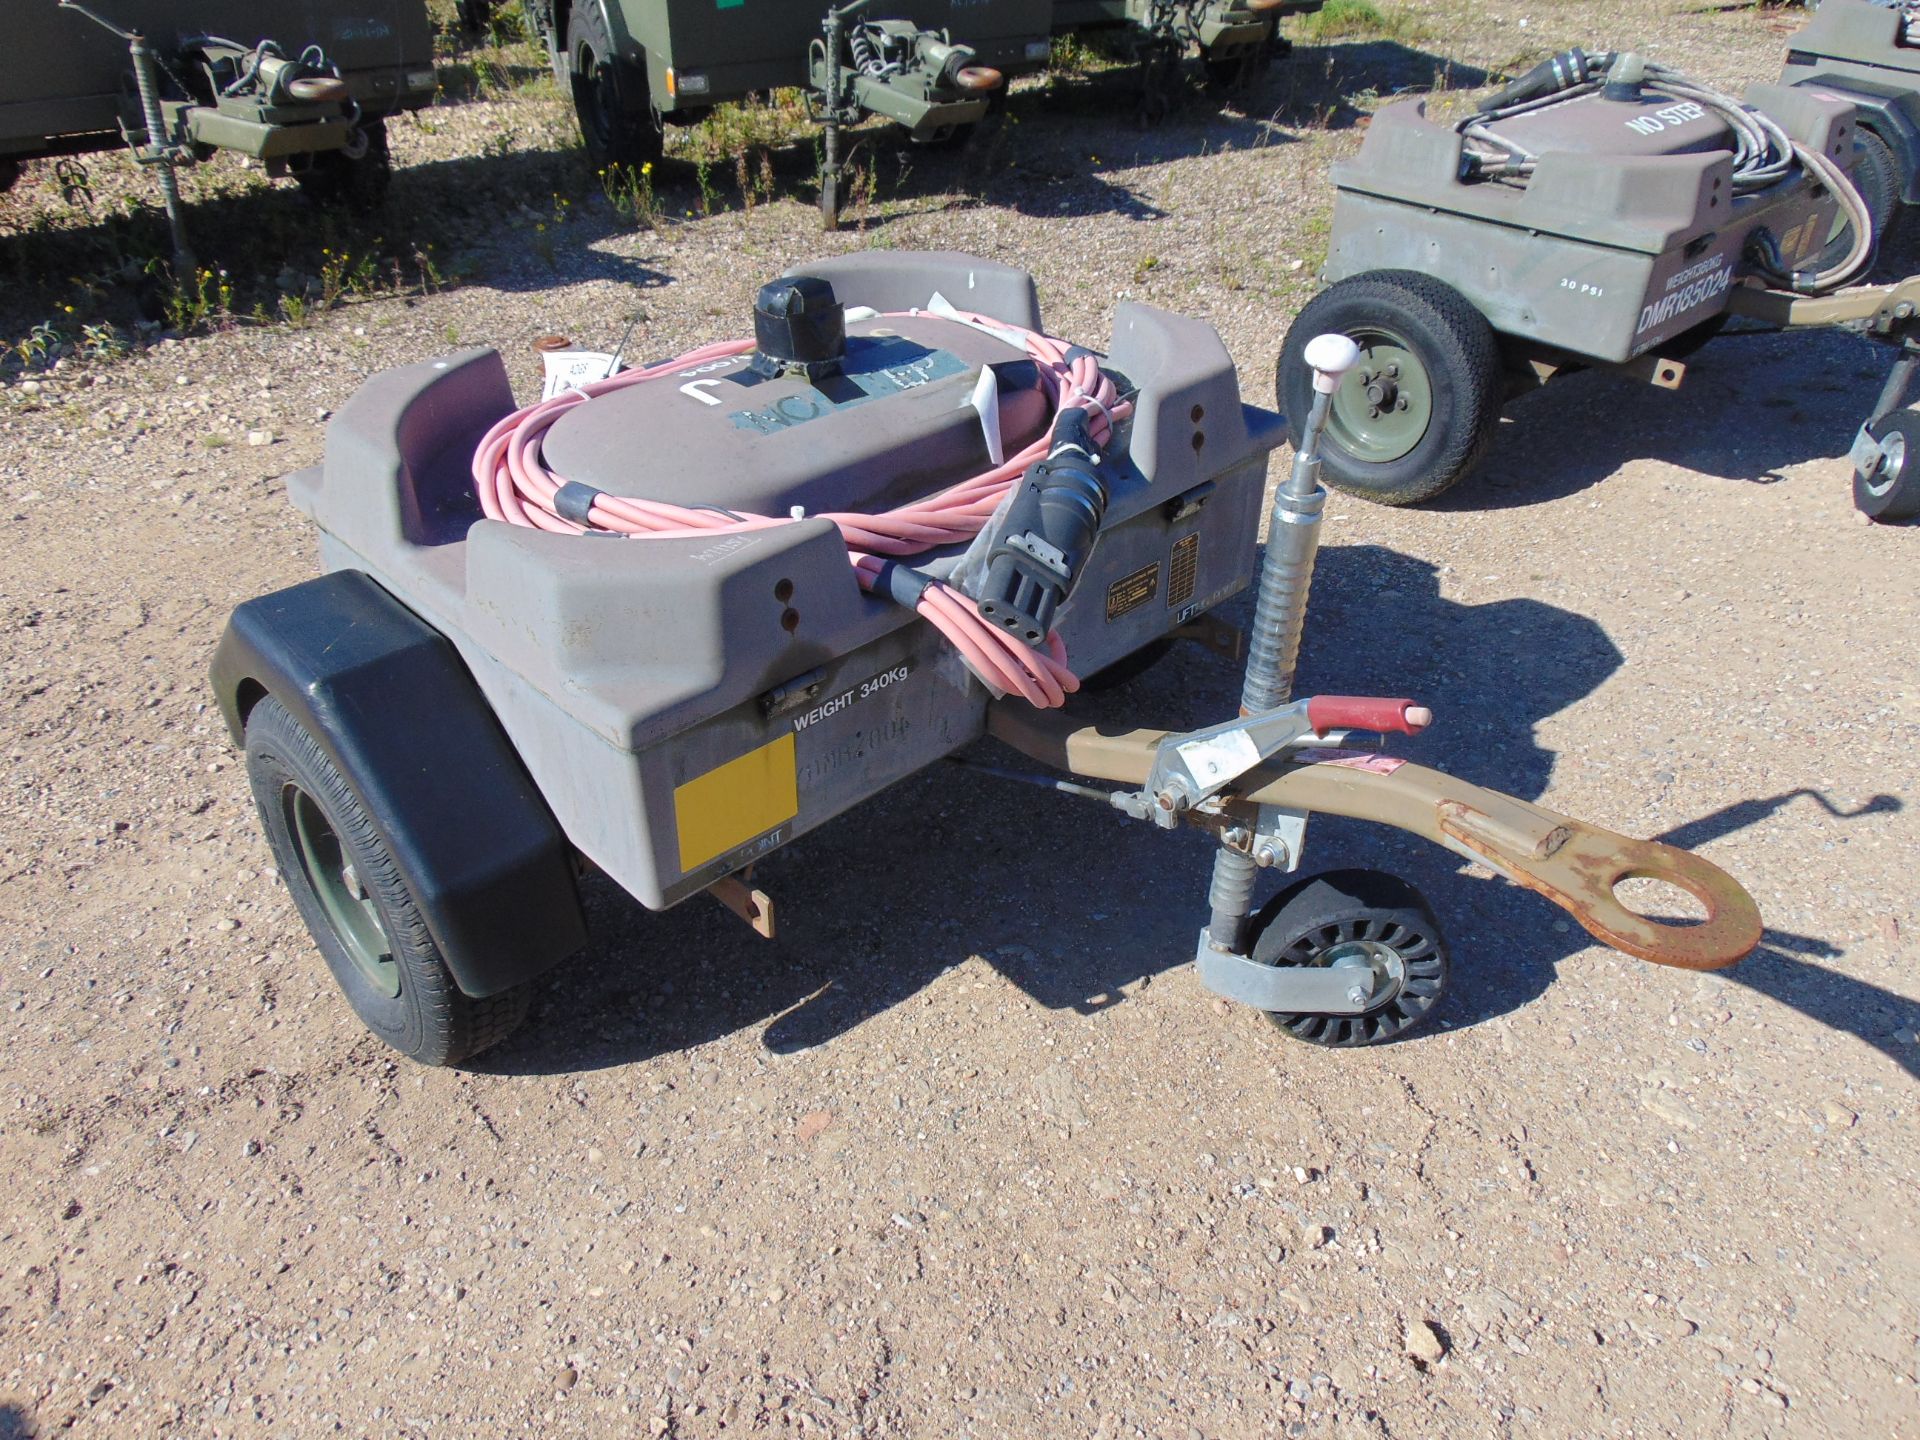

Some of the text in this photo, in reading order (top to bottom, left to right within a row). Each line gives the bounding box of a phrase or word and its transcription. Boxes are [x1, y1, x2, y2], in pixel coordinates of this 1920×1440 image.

[1624, 102, 1706, 136] NO STEP
[1560, 278, 1603, 297] 30 PSI
[1637, 265, 1732, 334] DMR185024
[794, 666, 908, 732] WEIGHT 340Kg
